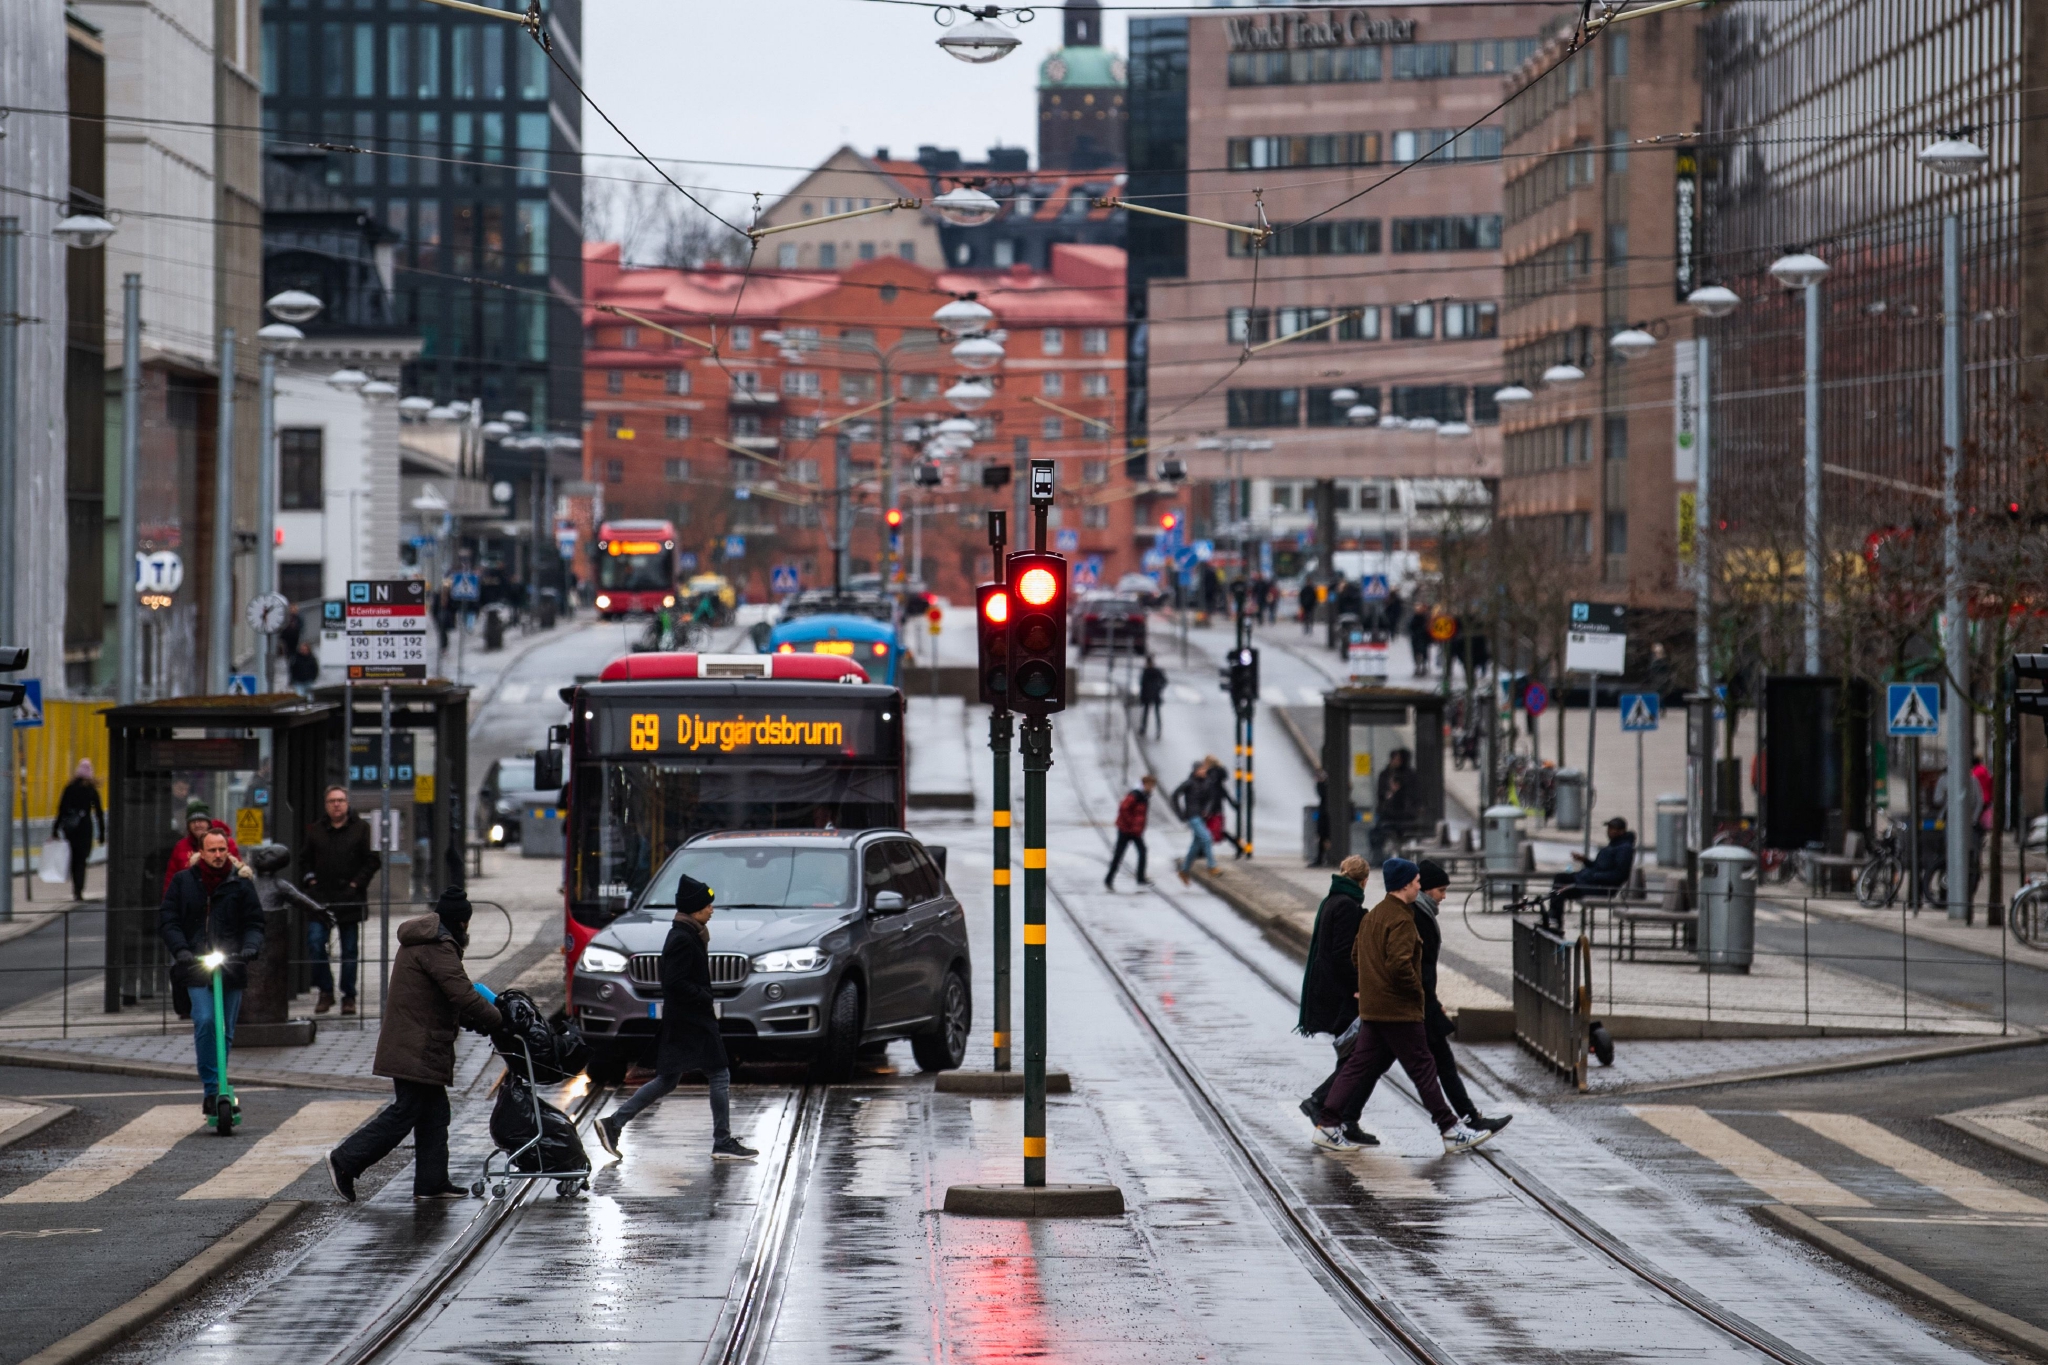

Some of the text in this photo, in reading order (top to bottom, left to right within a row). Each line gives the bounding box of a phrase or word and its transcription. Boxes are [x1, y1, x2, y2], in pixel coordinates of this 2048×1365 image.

[1222, 9, 1416, 48] World Trade Center
[376, 585, 389, 601] N
[350, 607, 392, 615] T-Centralen
[349, 618, 363, 628] 54
[376, 618, 390, 628] 65
[402, 618, 416, 628] 69
[349, 637, 422, 647] 190 191 192
[349, 650, 423, 660] 193 194 195
[630, 713, 843, 752] 69 Djurgårdsbrunn
